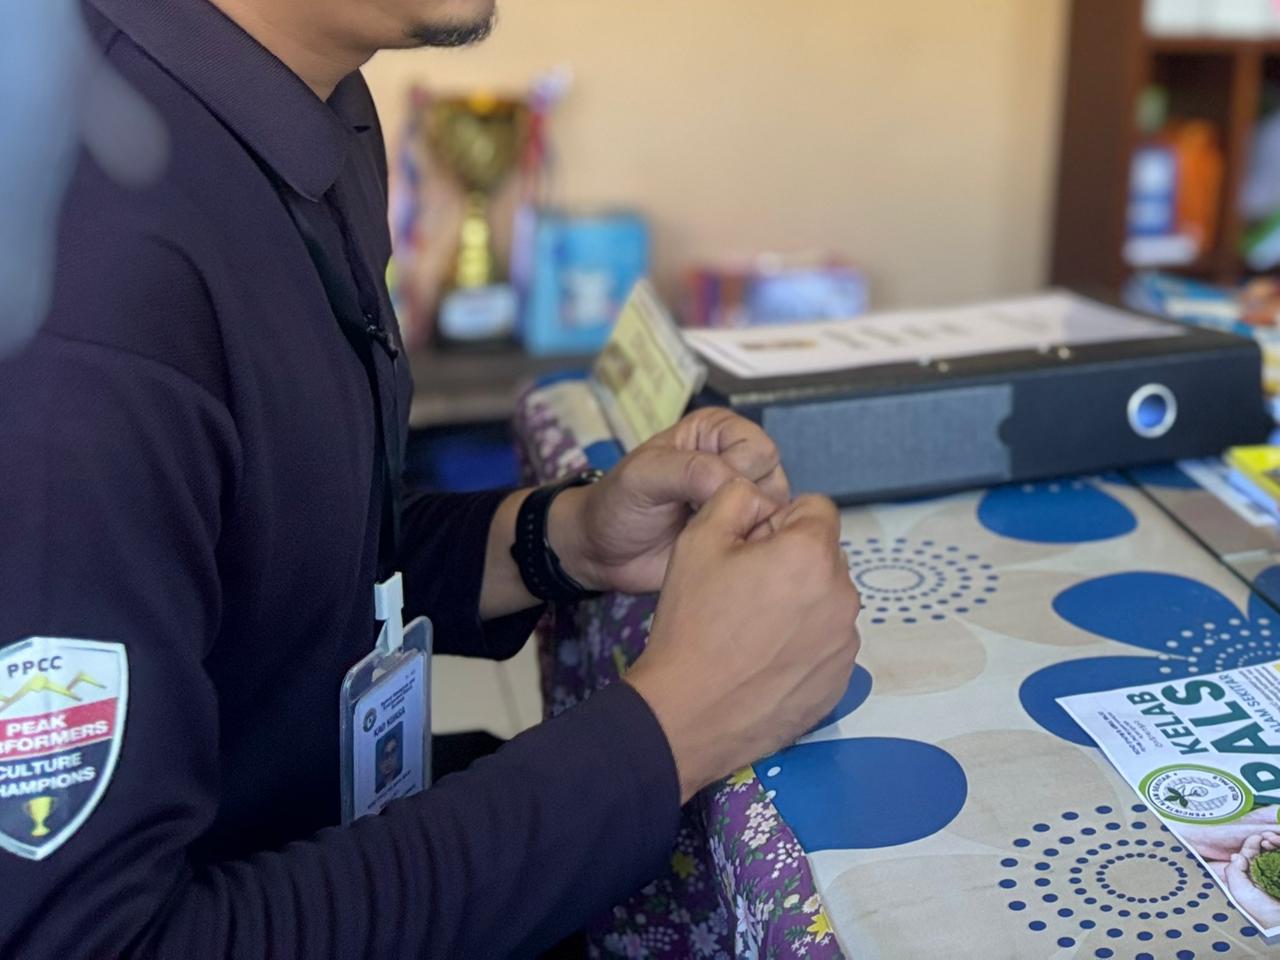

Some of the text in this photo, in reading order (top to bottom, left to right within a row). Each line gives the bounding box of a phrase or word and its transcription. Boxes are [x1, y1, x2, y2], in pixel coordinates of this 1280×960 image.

[7, 656, 63, 679] PPCC
[1215, 672, 1262, 708] SEKITAR
[6, 714, 67, 737] PEAK
[1126, 690, 1211, 756] KELAB
